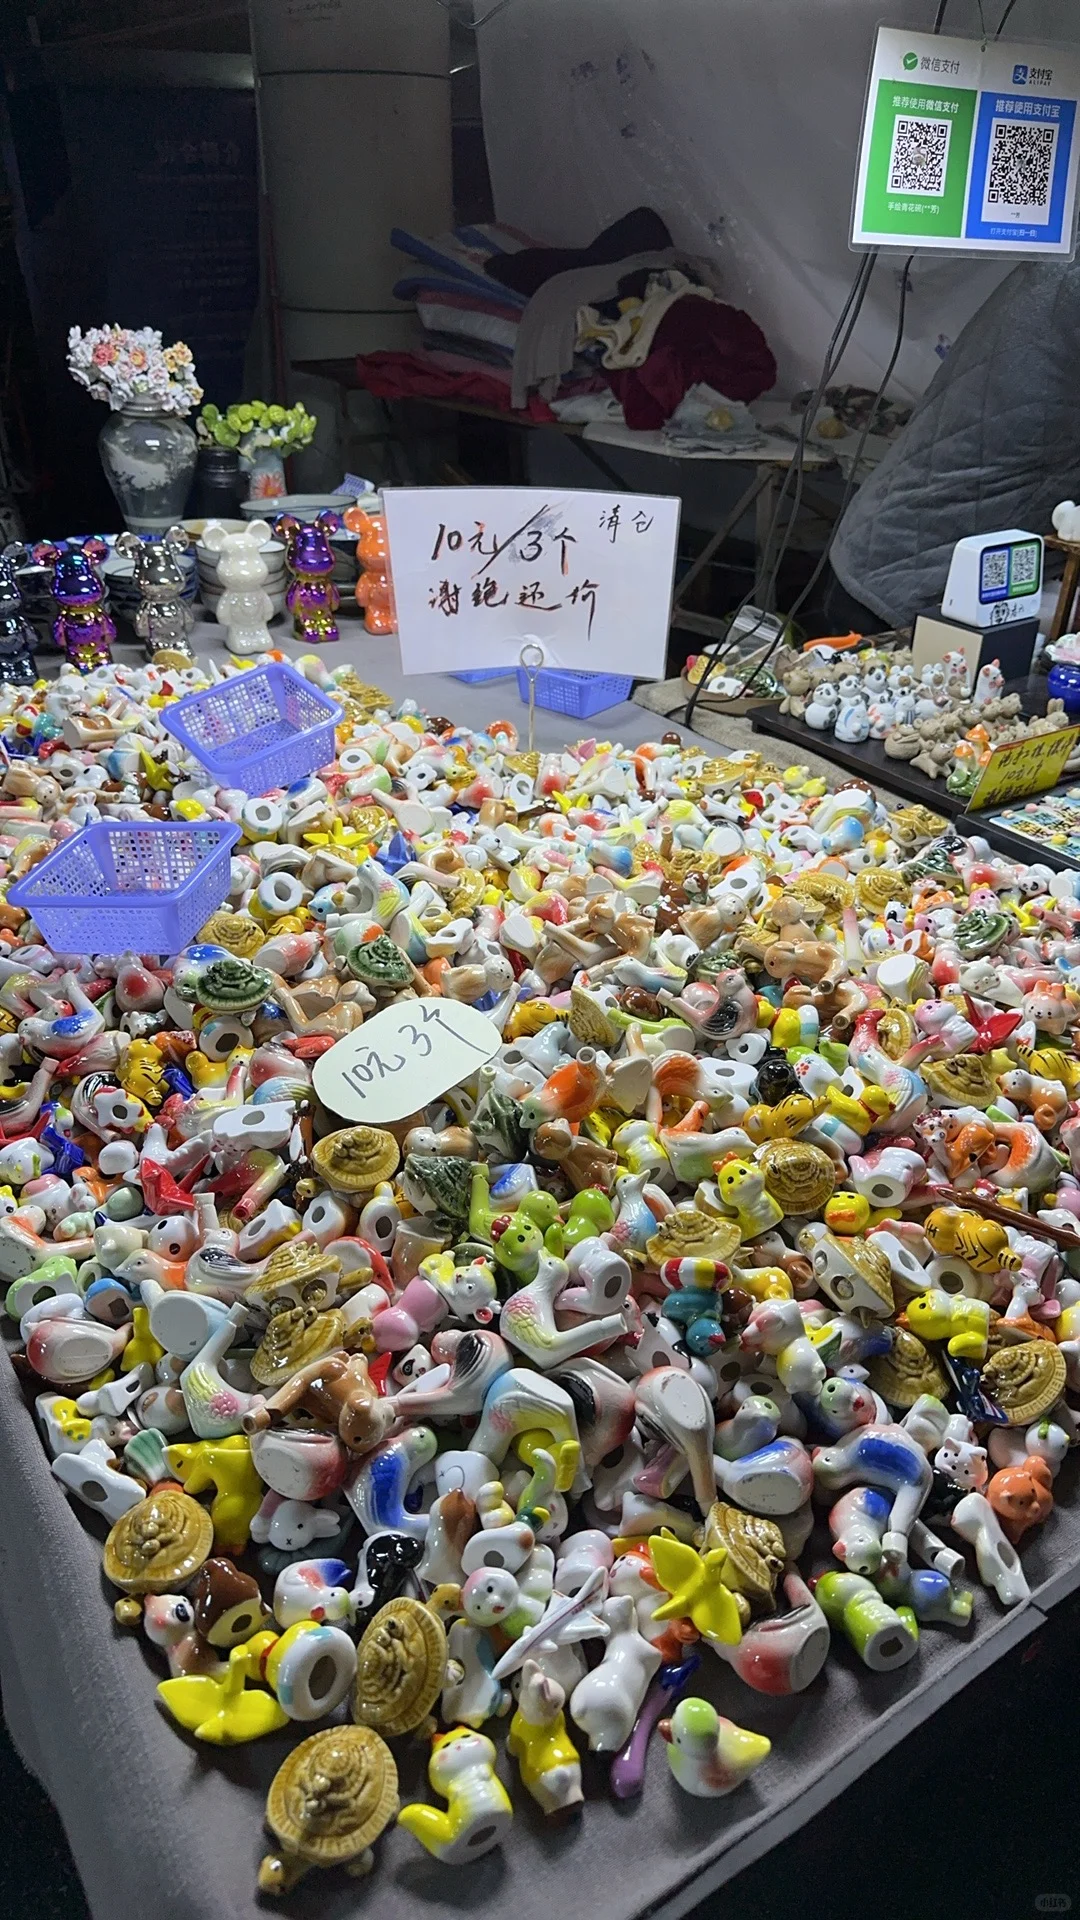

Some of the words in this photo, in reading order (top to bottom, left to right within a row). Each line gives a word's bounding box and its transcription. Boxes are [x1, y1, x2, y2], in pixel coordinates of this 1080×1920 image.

[920, 56, 960, 75] 微信支付
[1029, 68, 1053, 80] 支付宝
[892, 96, 959, 114] 推荐使用微信支付
[995, 100, 1061, 118] 推荐使用支付宝
[599, 504, 653, 543] 清仓
[428, 576, 600, 641] 谢绝还价
[341, 1004, 491, 1099] 10元3个
